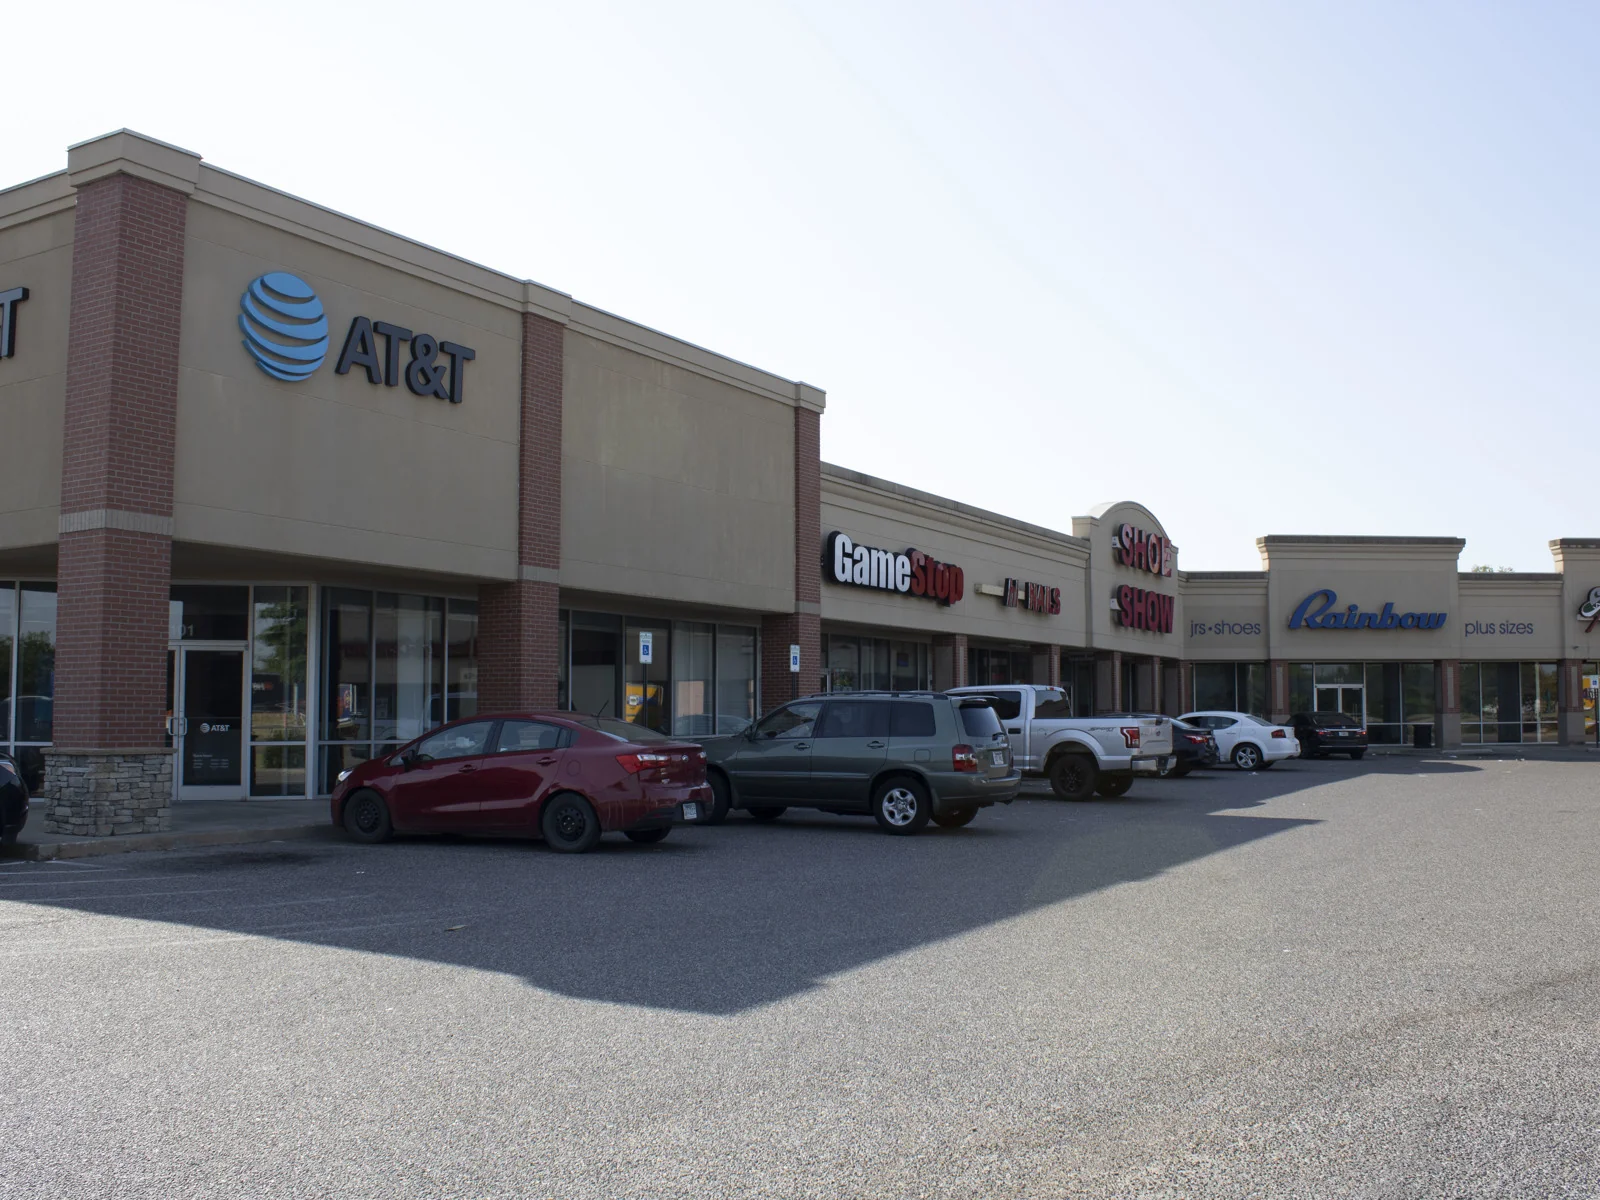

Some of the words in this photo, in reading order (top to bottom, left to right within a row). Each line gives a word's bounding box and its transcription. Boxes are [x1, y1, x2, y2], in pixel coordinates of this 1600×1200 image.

[334, 315, 476, 404] AT&T
[828, 531, 965, 607] GameStop
[1118, 523, 1172, 577] SHOE
[1117, 584, 1175, 634] SHOW
[1288, 588, 1448, 631] Rainbow
[1464, 620, 1496, 637] plus
[1499, 620, 1534, 635] sizes
[210, 724, 230, 732] AT&T
